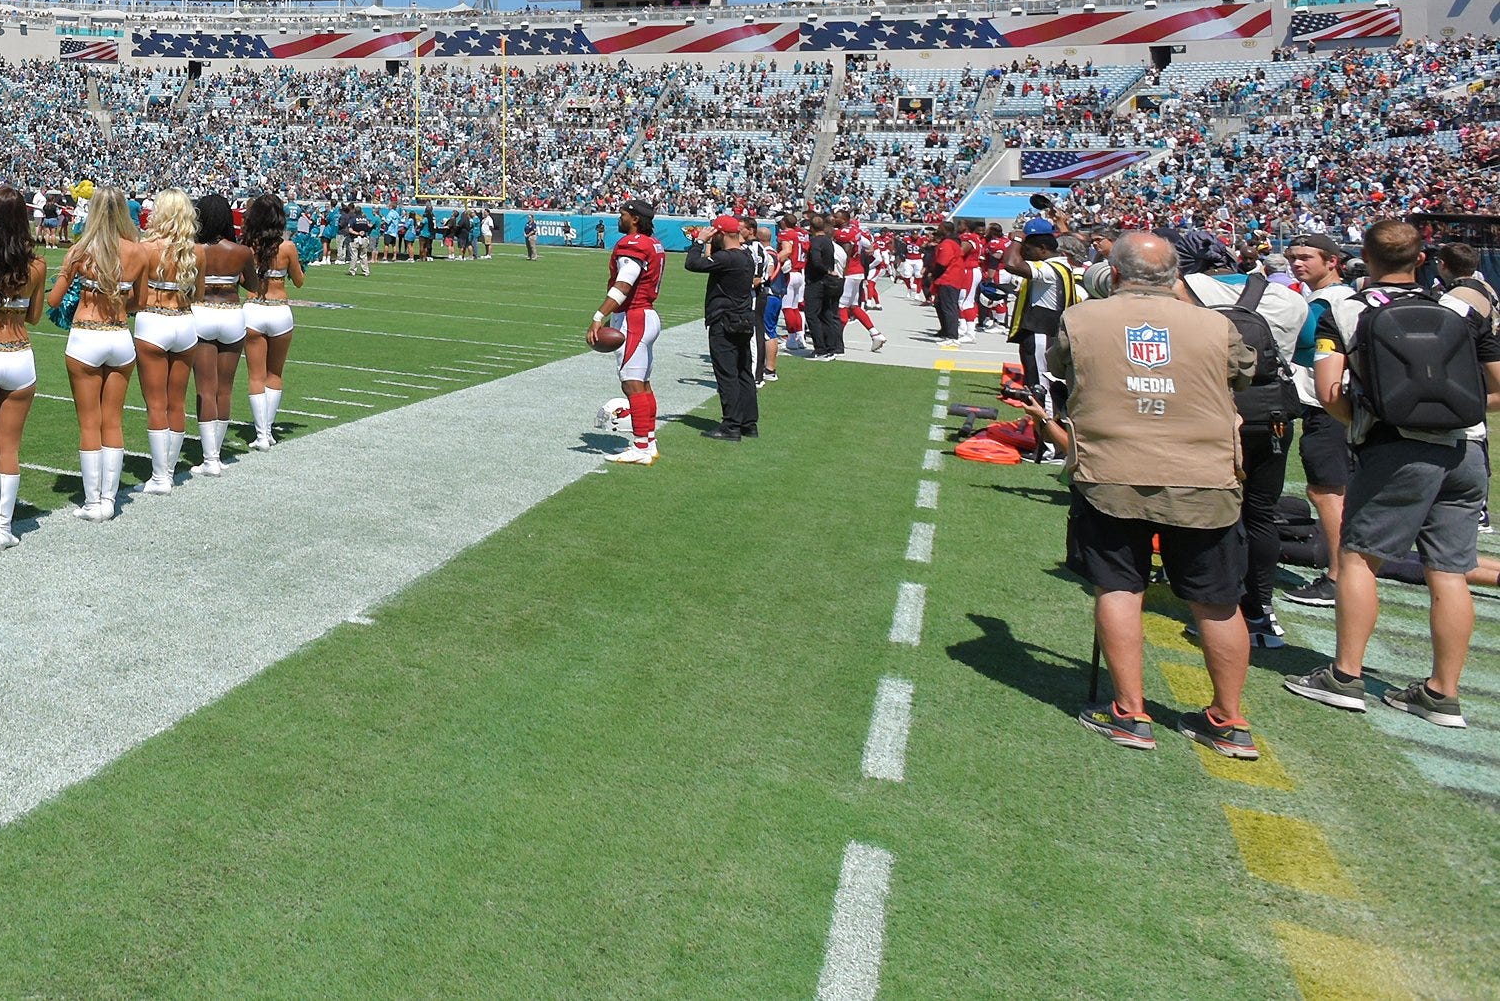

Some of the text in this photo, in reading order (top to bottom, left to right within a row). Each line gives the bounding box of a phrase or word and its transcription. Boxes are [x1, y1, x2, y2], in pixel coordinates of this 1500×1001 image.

[289, 209, 298, 219] 16
[535, 226, 577, 239] AGUAS
[1131, 342, 1165, 363] NFL
[1126, 376, 1176, 394] MEDIA
[1136, 398, 1165, 415] 179
